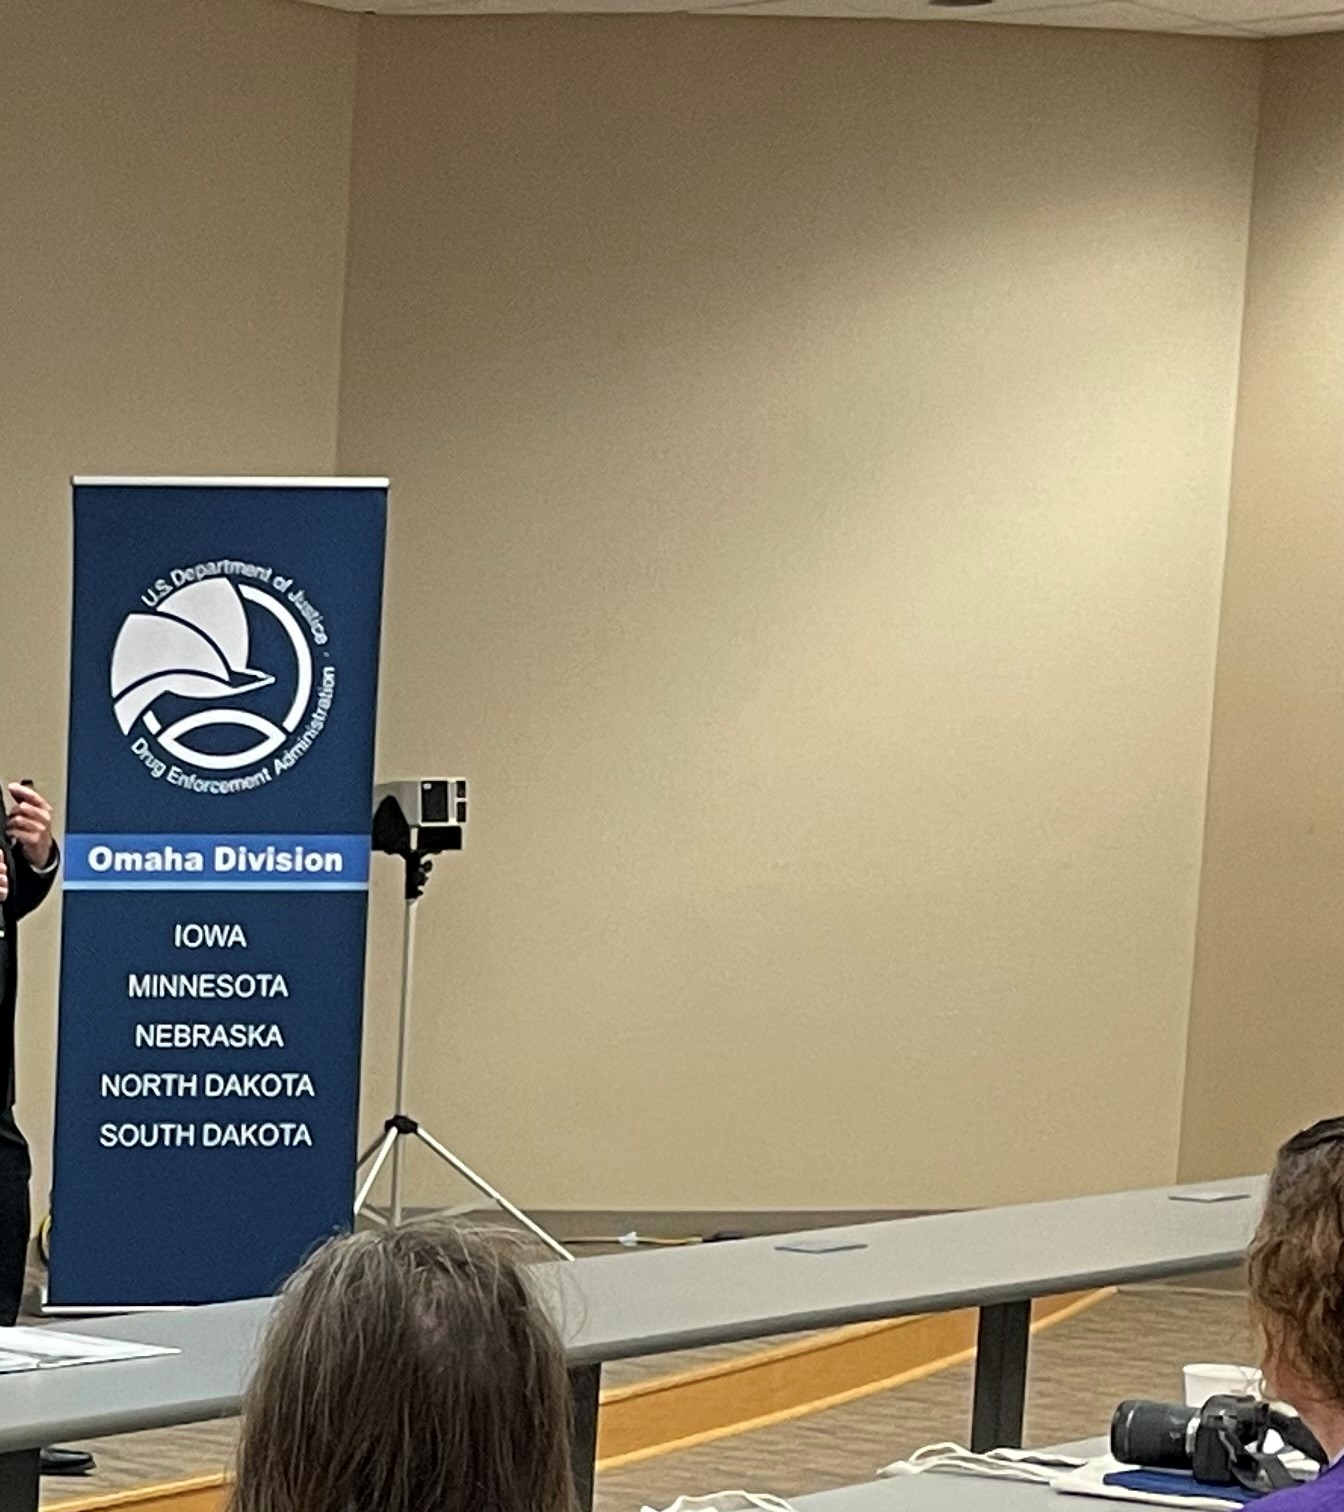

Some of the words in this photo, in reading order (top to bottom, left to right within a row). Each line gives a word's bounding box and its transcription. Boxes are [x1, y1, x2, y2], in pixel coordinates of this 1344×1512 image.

[170, 559, 273, 587] Department
[272, 577, 293, 594] of
[287, 589, 329, 645] Justice
[130, 736, 169, 778] Drug
[165, 766, 274, 795] Enforcement
[273, 665, 337, 776] Administration
[88, 845, 204, 874] Omaha
[214, 845, 344, 874] Division
[174, 924, 247, 949] IOWA
[128, 974, 289, 999] MINNESOTA
[134, 1024, 285, 1049] NEBRASKA
[100, 1073, 198, 1098] NORTH
[204, 1073, 315, 1098] DAKOTA
[99, 1123, 195, 1148] SOUTH
[202, 1123, 313, 1148] DAKOTA
